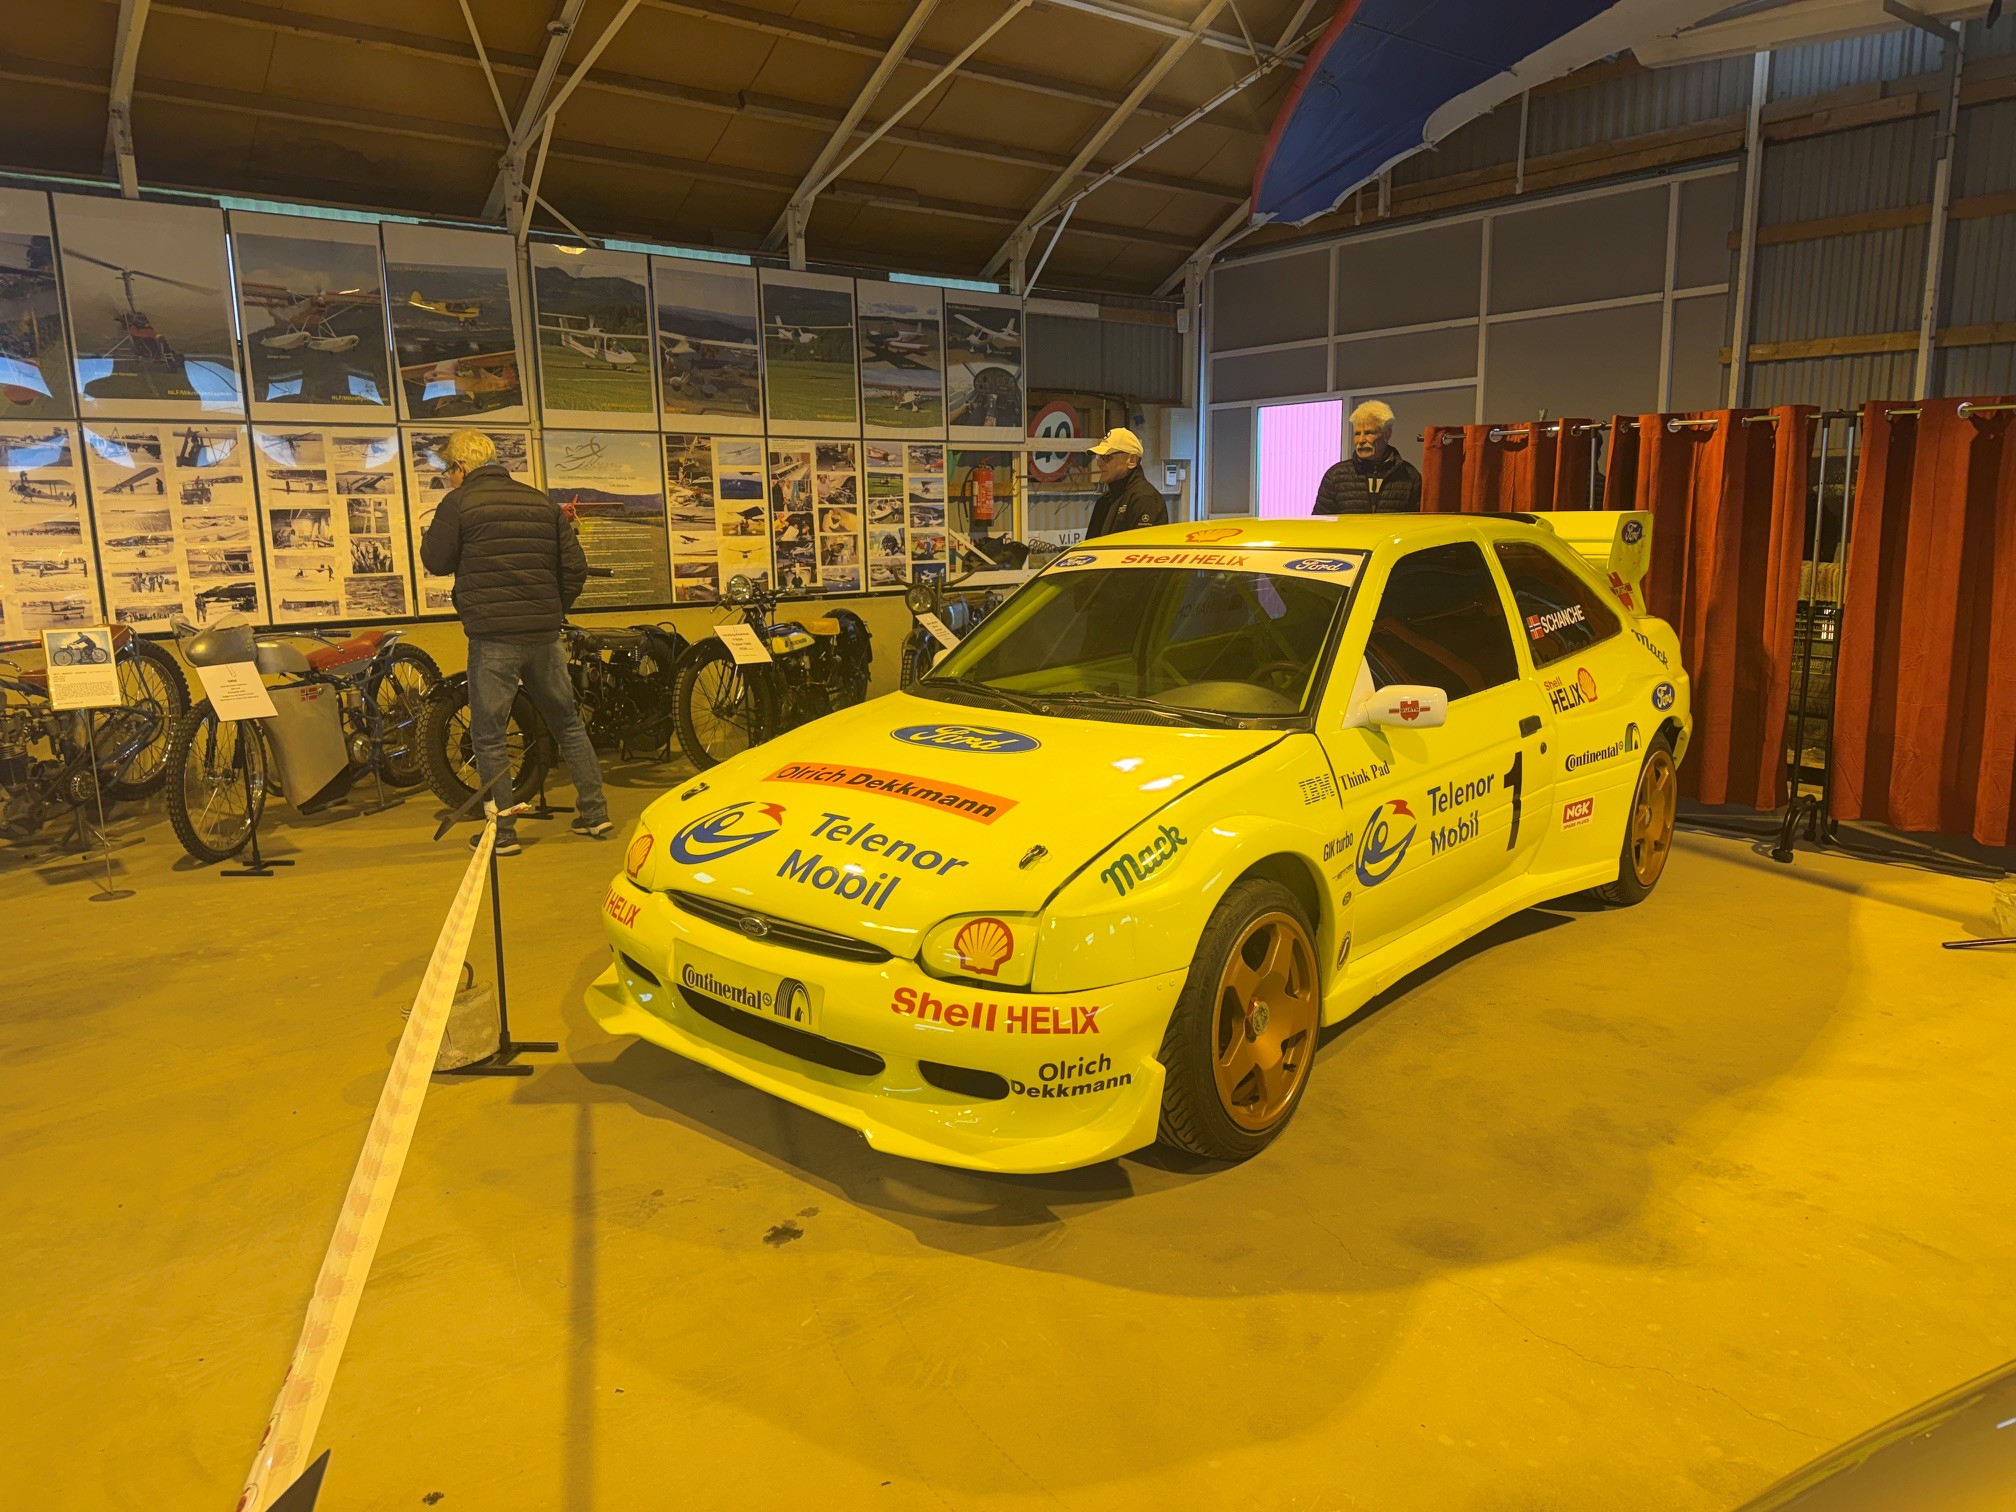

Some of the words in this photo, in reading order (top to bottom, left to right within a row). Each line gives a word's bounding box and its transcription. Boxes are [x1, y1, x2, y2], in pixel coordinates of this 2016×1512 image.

[1035, 421, 1072, 463] 40
[1625, 522, 1642, 542] Ford
[1121, 553, 1189, 565] Shell
[1188, 554, 1250, 567] HELIX
[1295, 558, 1344, 572] Ford
[1540, 604, 1586, 634] SCHANCHE
[1543, 676, 1563, 691] Shell
[1548, 682, 1586, 714] HELIX
[1656, 685, 1674, 709] Ford
[909, 725, 1018, 750] Ford
[1565, 742, 1619, 772] Continental
[1298, 773, 1336, 806] IBM
[1339, 768, 1371, 791] Think
[1370, 760, 1391, 780] Pad
[776, 765, 847, 783] Olrich
[845, 772, 997, 818] Dekkmann
[1427, 773, 1495, 816] Telenor
[1503, 750, 1523, 852] 1
[1565, 800, 1591, 820] NGK
[810, 812, 970, 876] Telenor
[1335, 830, 1354, 855] turbo
[1430, 809, 1479, 856] Mobil
[1100, 824, 1188, 897] Mack
[775, 848, 902, 911] Mobil
[605, 891, 642, 930] HELIX
[681, 962, 763, 1011] Continental
[890, 986, 998, 1032] Shell
[1006, 1005, 1101, 1035] HELIX
[1037, 1052, 1112, 1082] Olrich
[1010, 1071, 1132, 1099] Dekkmann
